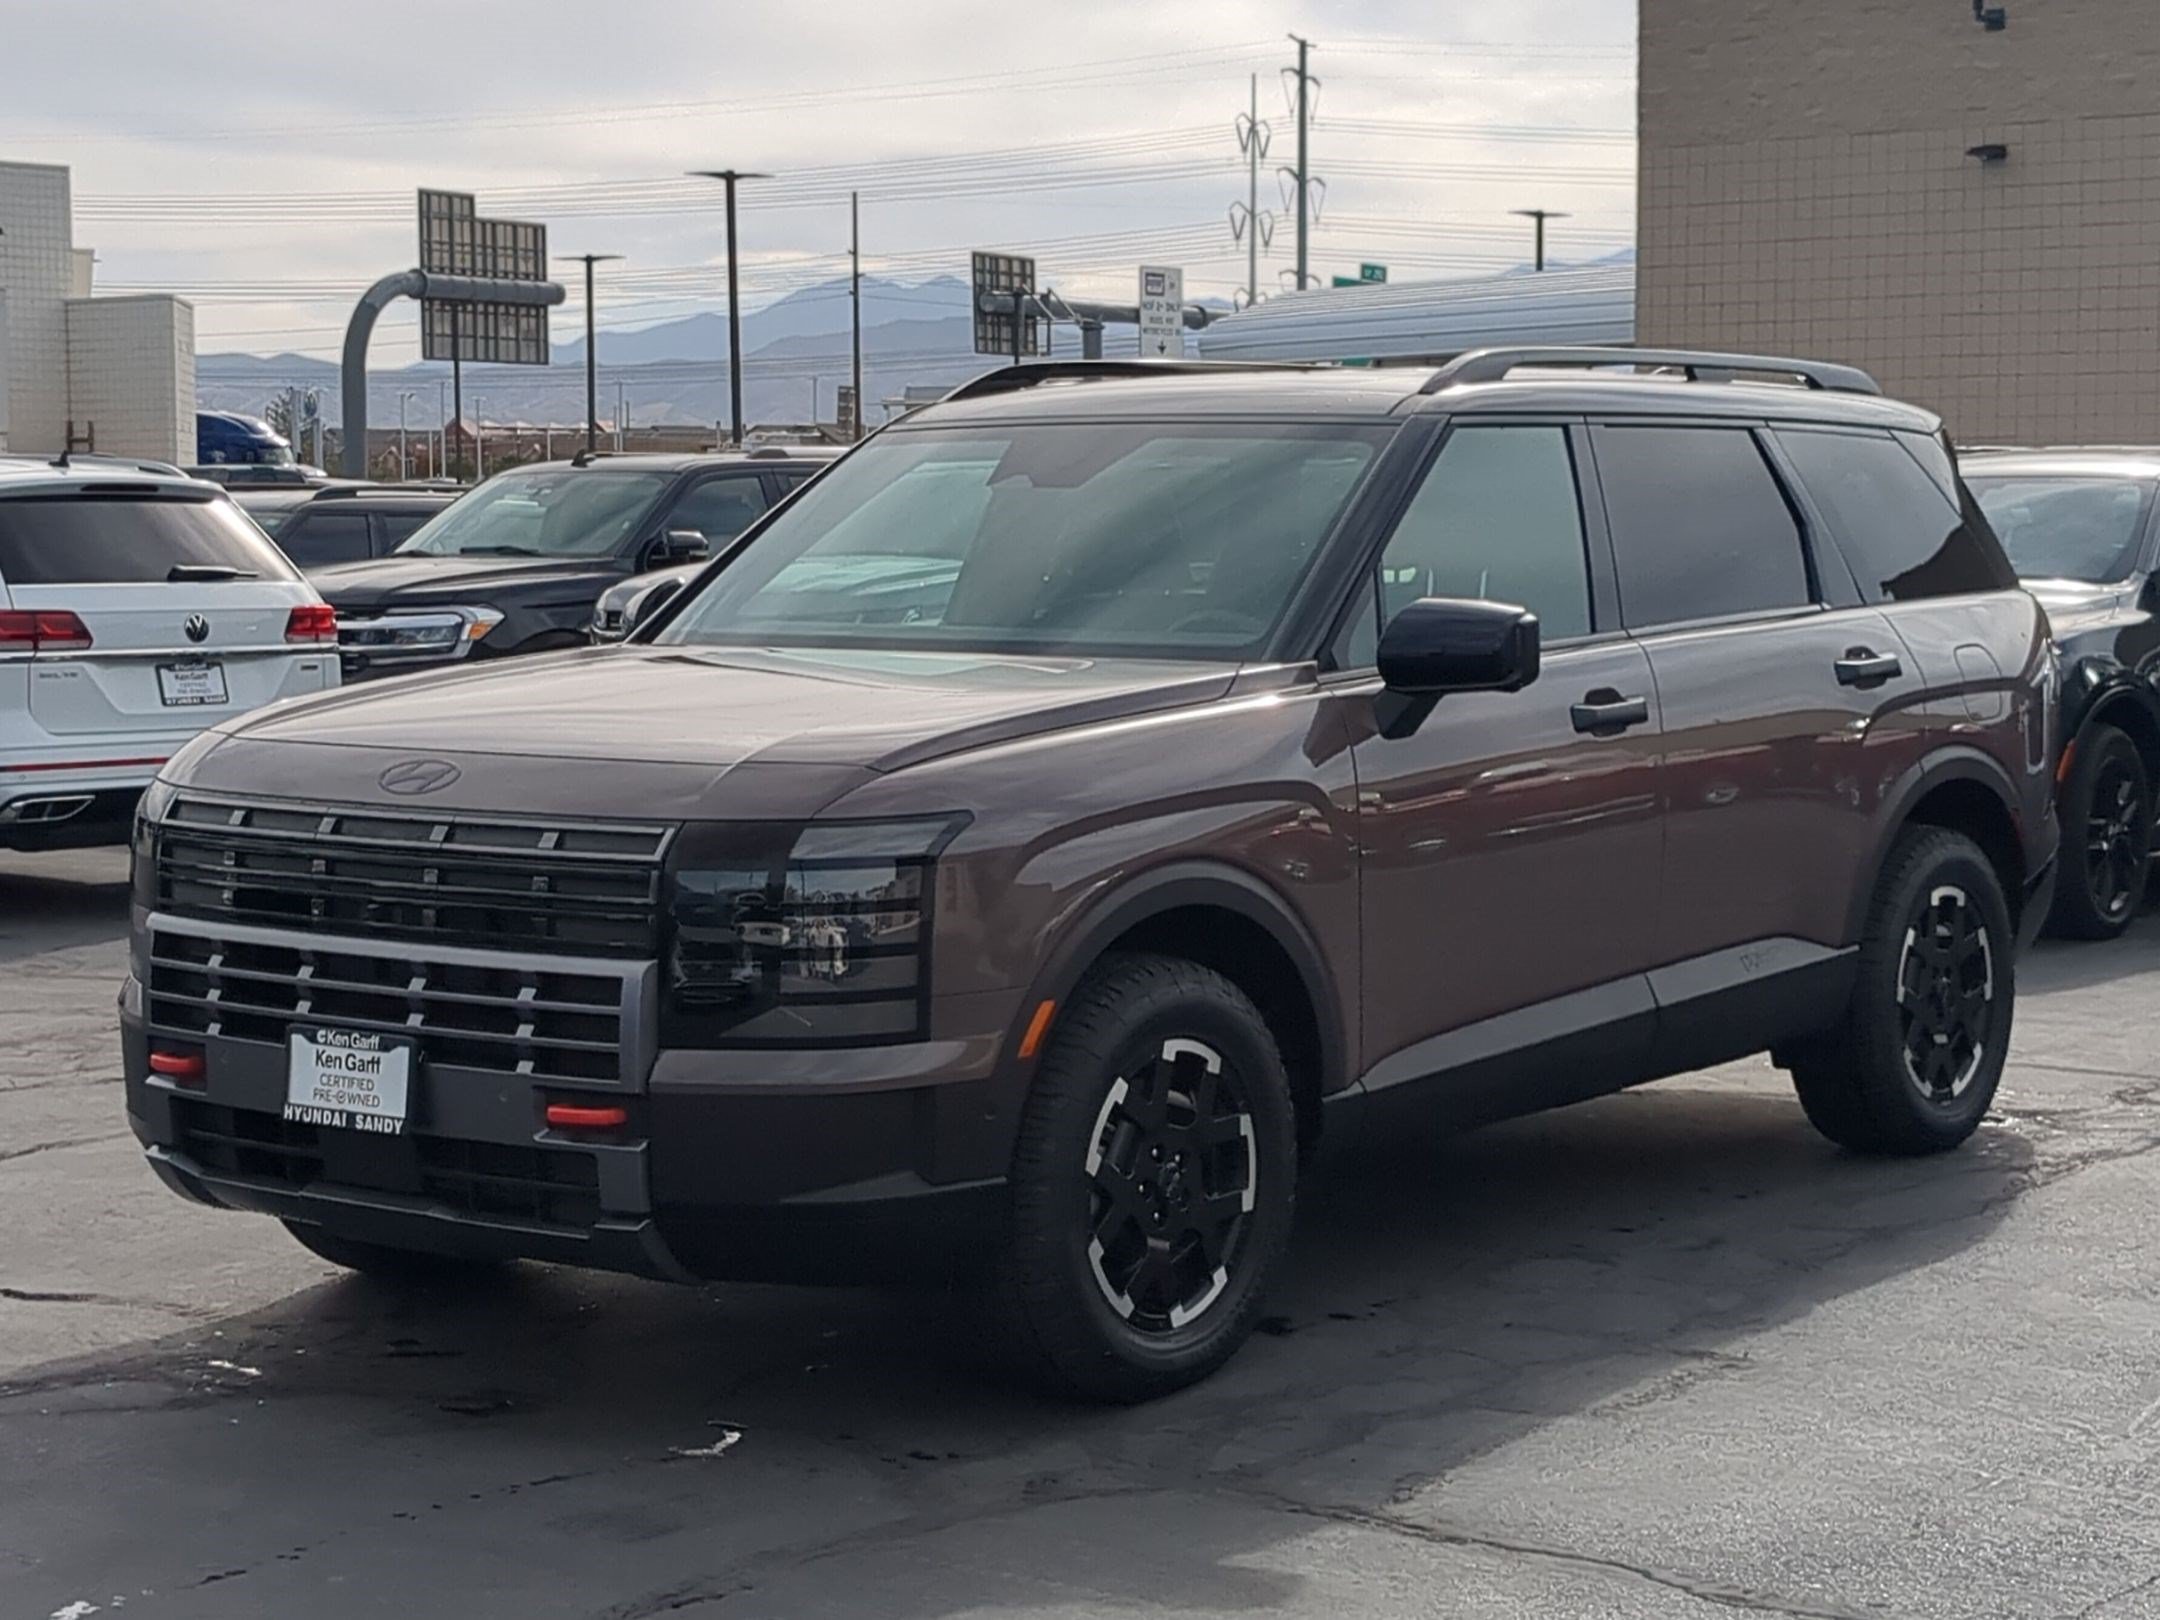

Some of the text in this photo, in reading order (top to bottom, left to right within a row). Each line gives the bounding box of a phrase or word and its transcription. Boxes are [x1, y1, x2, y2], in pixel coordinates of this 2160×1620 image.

[326, 1029, 380, 1050] Ken Garff
[314, 1048, 382, 1074] Ken Garff
[319, 1073, 375, 1092] CERTIFIED
[283, 1104, 403, 1135] HYUNDAI SANDY
